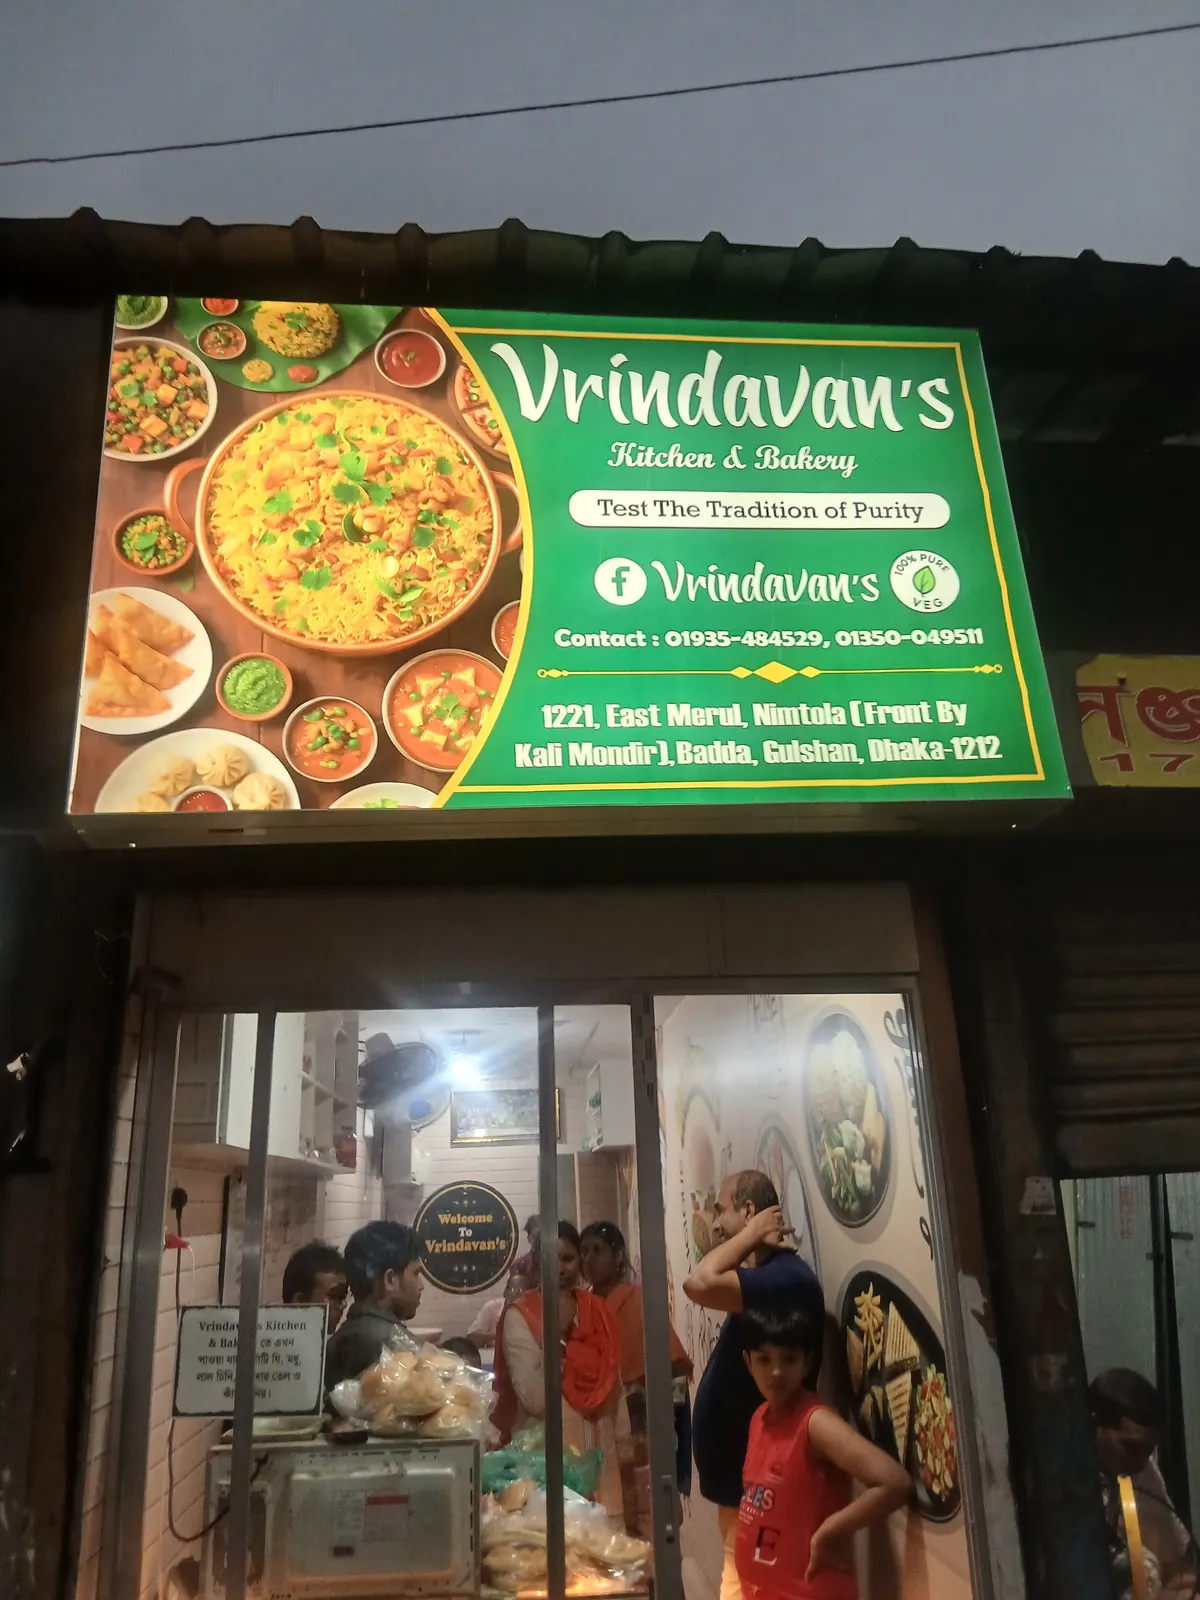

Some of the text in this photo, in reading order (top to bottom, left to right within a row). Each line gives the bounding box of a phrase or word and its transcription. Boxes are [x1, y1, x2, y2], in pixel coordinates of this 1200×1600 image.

[490, 342, 954, 432] Vrindavan's
[607, 441, 859, 478] Kitchen & Bakery
[597, 499, 924, 523] Test The Tradition of Purity
[894, 553, 950, 576] 100% PURE
[650, 560, 880, 604] Vrindavan's
[913, 597, 943, 610] VEG
[554, 628, 647, 648] Contact
[664, 629, 831, 649] 01935-484529,
[835, 628, 984, 647] 01350-049511
[541, 704, 600, 730] 1221,
[606, 703, 662, 728] East
[666, 702, 749, 729] Merul,
[752, 702, 847, 726] Nimtola
[935, 700, 967, 726] By
[514, 743, 563, 768] Kali
[762, 739, 865, 766] Gulshan,
[867, 735, 1003, 762] Dhaka-1212
[439, 1213, 493, 1224] Welcome
[458, 1227, 473, 1237] To
[425, 1237, 506, 1253] Vrindavan's
[266, 1320, 306, 1330] Kitchen
[208, 1338, 216, 1348] &
